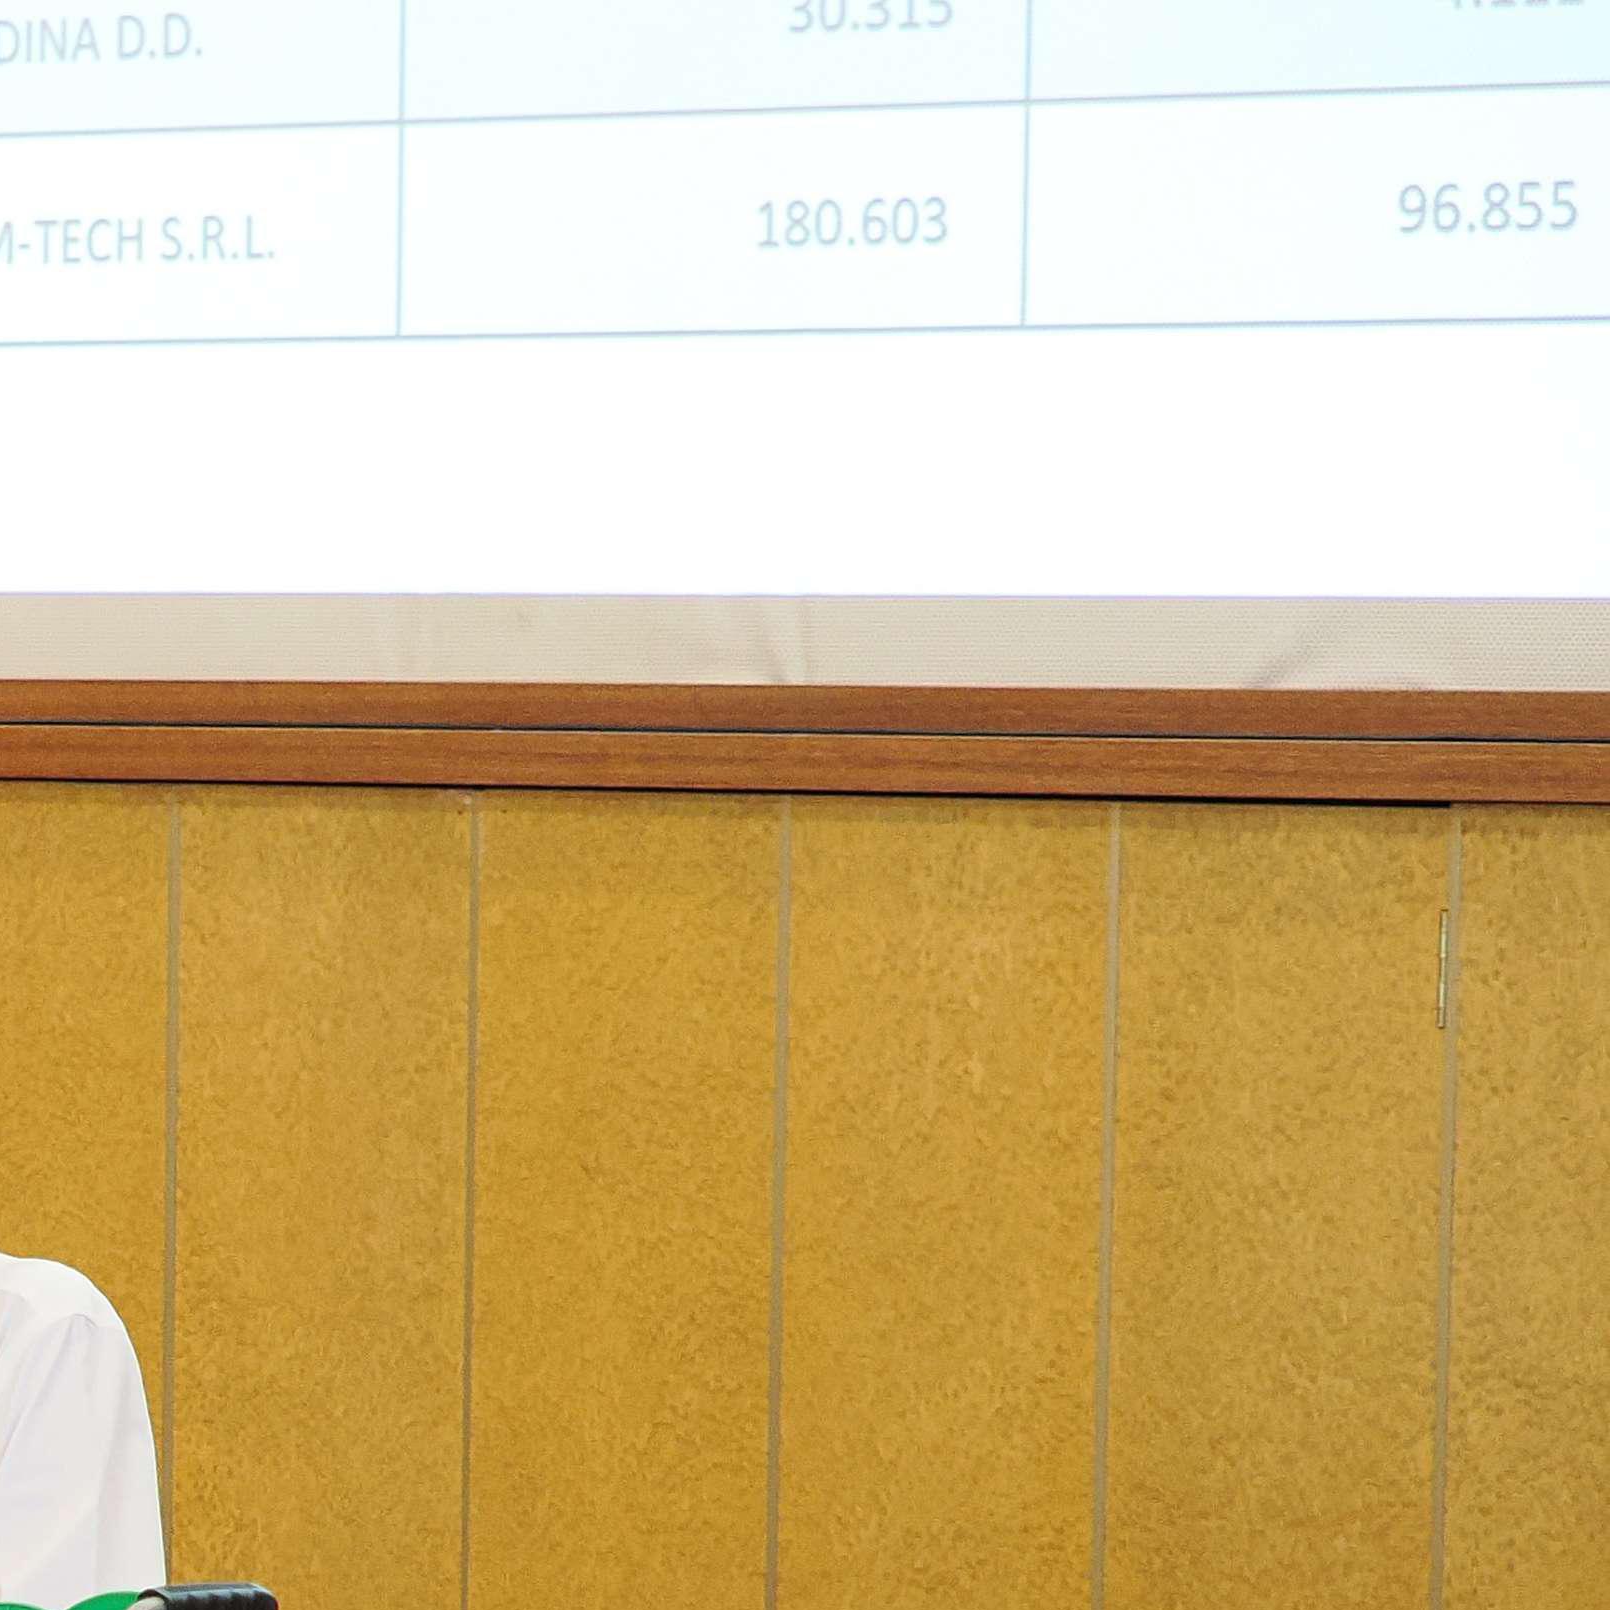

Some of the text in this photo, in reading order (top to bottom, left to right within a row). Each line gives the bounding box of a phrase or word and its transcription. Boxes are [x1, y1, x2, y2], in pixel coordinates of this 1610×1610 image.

[116, 12, 204, 61] D.D.
[757, 196, 948, 249] 180.603
[1398, 180, 1579, 235] 96.855
[160, 215, 276, 263] S.R.L.
